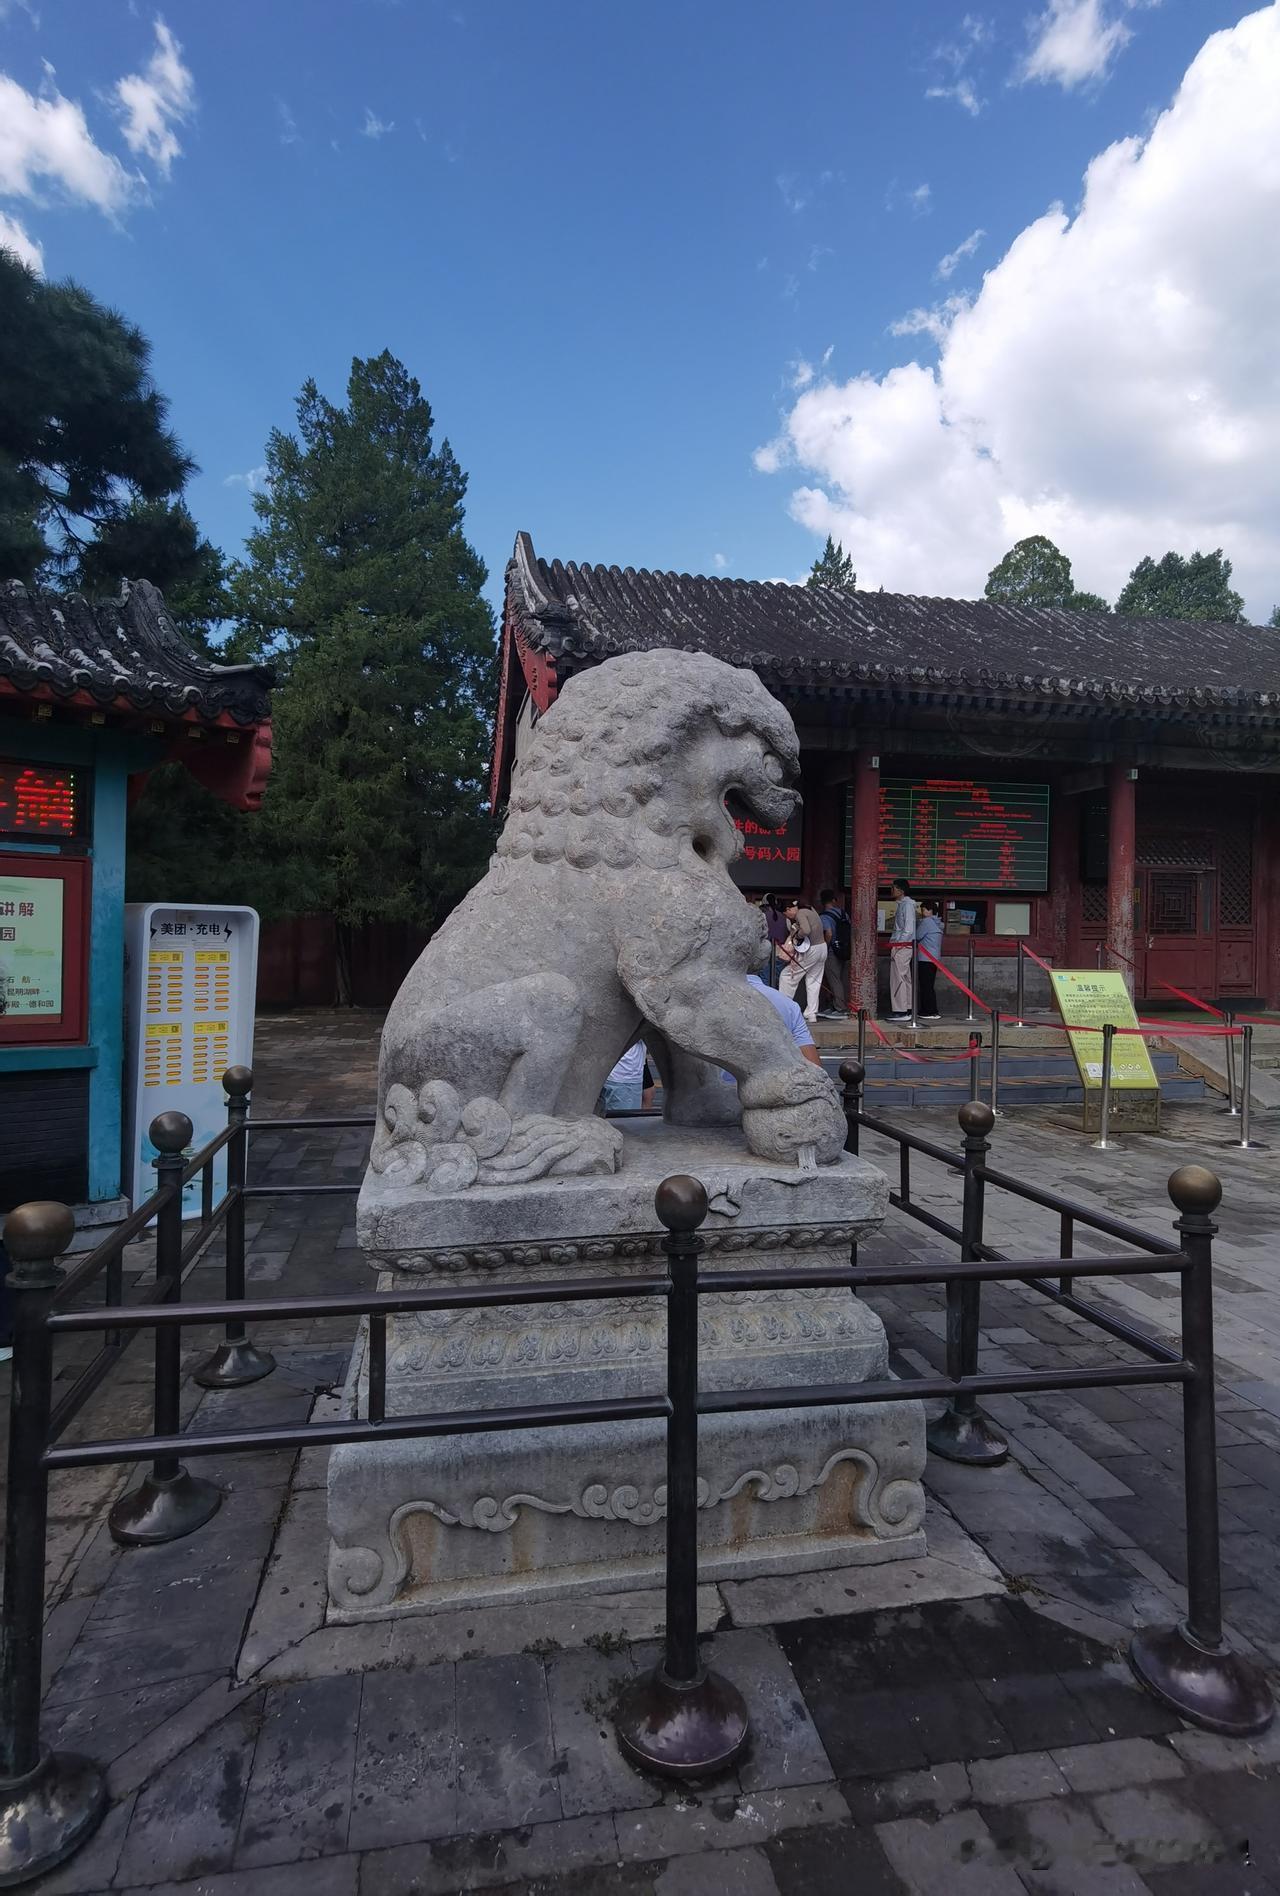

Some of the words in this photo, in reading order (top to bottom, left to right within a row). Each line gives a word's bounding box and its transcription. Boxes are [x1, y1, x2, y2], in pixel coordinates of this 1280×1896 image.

[736, 846, 800, 861] 号码入园
[0, 902, 34, 916] 讲解
[161, 923, 221, 935] 美团·充电
[1077, 984, 1105, 992] 温馨提示
